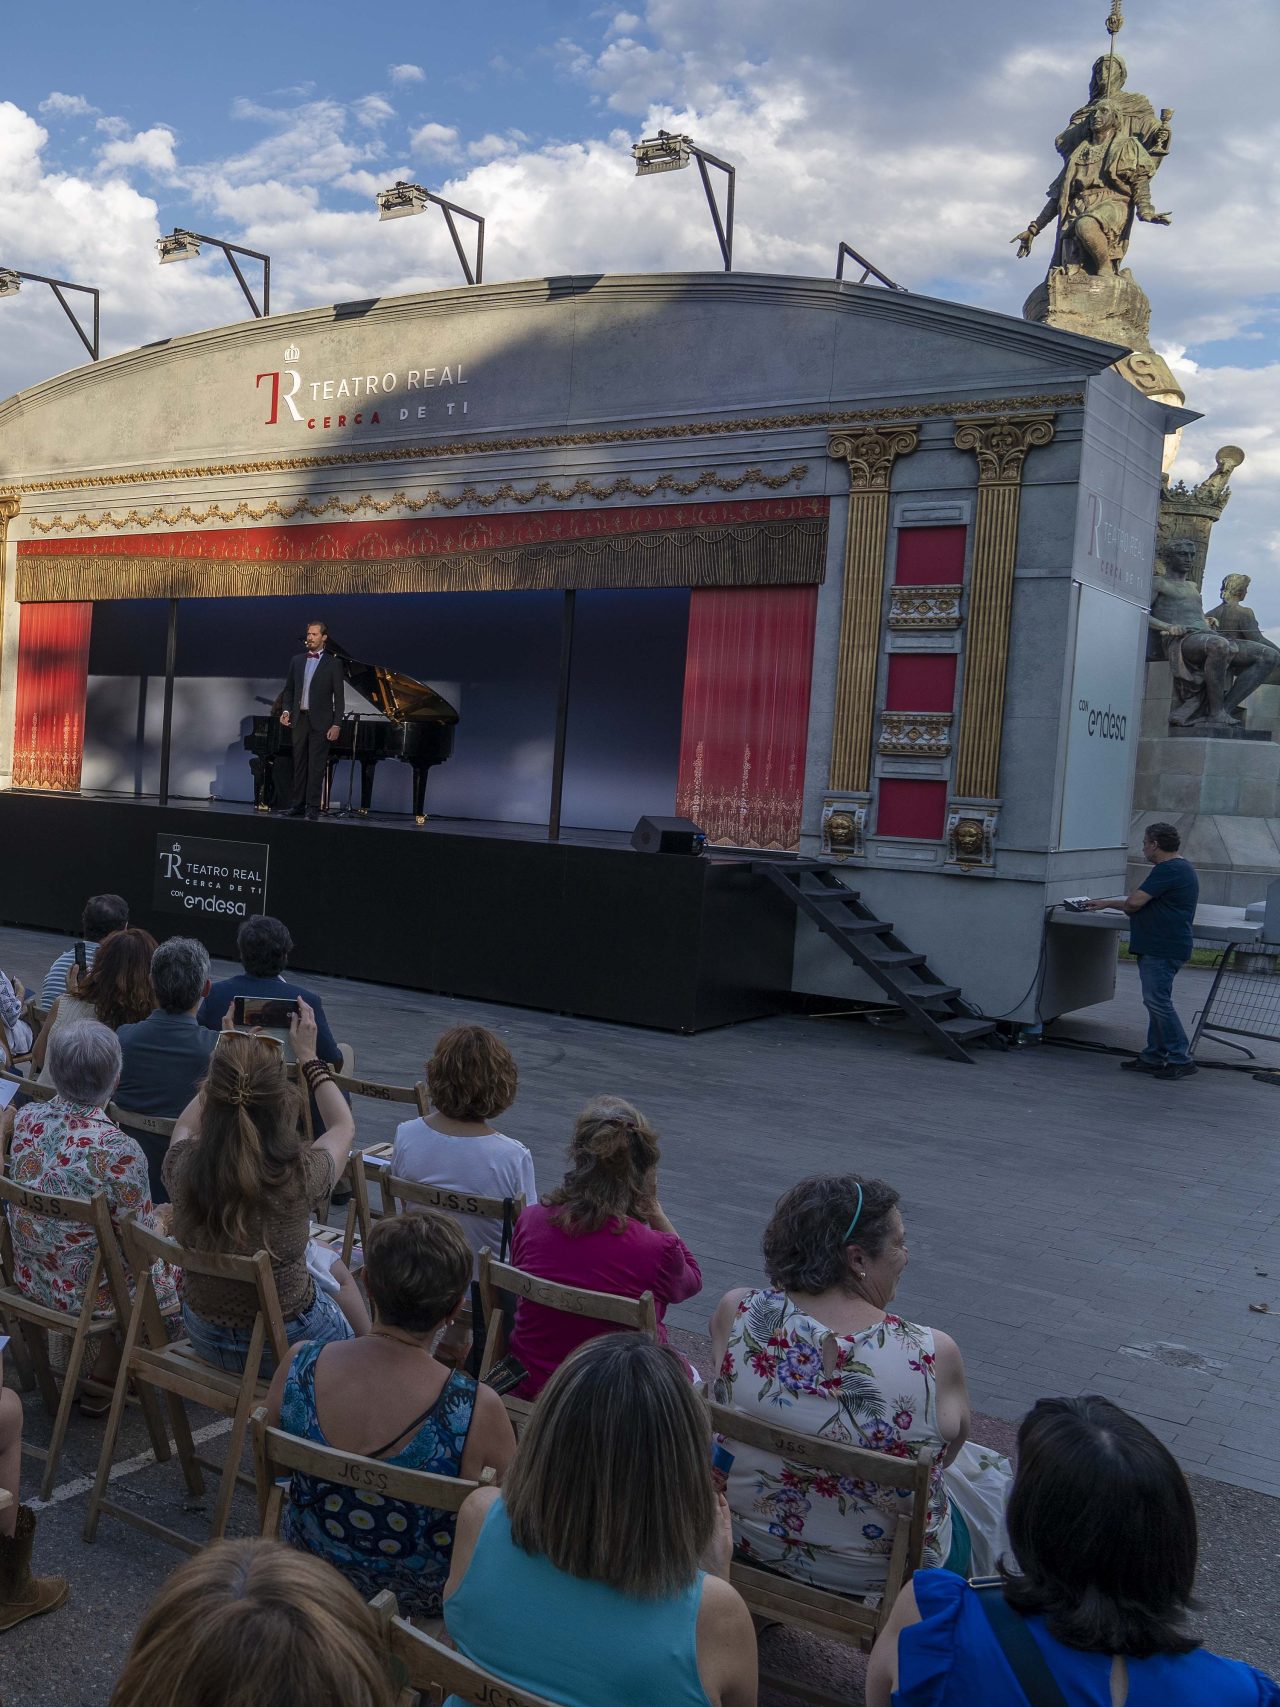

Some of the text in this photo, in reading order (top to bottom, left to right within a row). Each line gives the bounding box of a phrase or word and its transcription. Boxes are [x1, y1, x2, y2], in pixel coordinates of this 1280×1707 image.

[310, 364, 468, 400] TEATRO REAL
[307, 402, 468, 429] CERCA DE TI
[1103, 520, 1144, 560] TEATRO REAL
[1101, 560, 1122, 581] CERCA
[1125, 571, 1133, 585] DE
[1079, 699, 1126, 741] CON endesa
[185, 879, 221, 888] CERCA
[186, 863, 261, 881] TEATRO REAL
[184, 895, 246, 916] endesa
[20, 1191, 68, 1216] J.S.S.
[431, 1191, 485, 1215] J.S.S.
